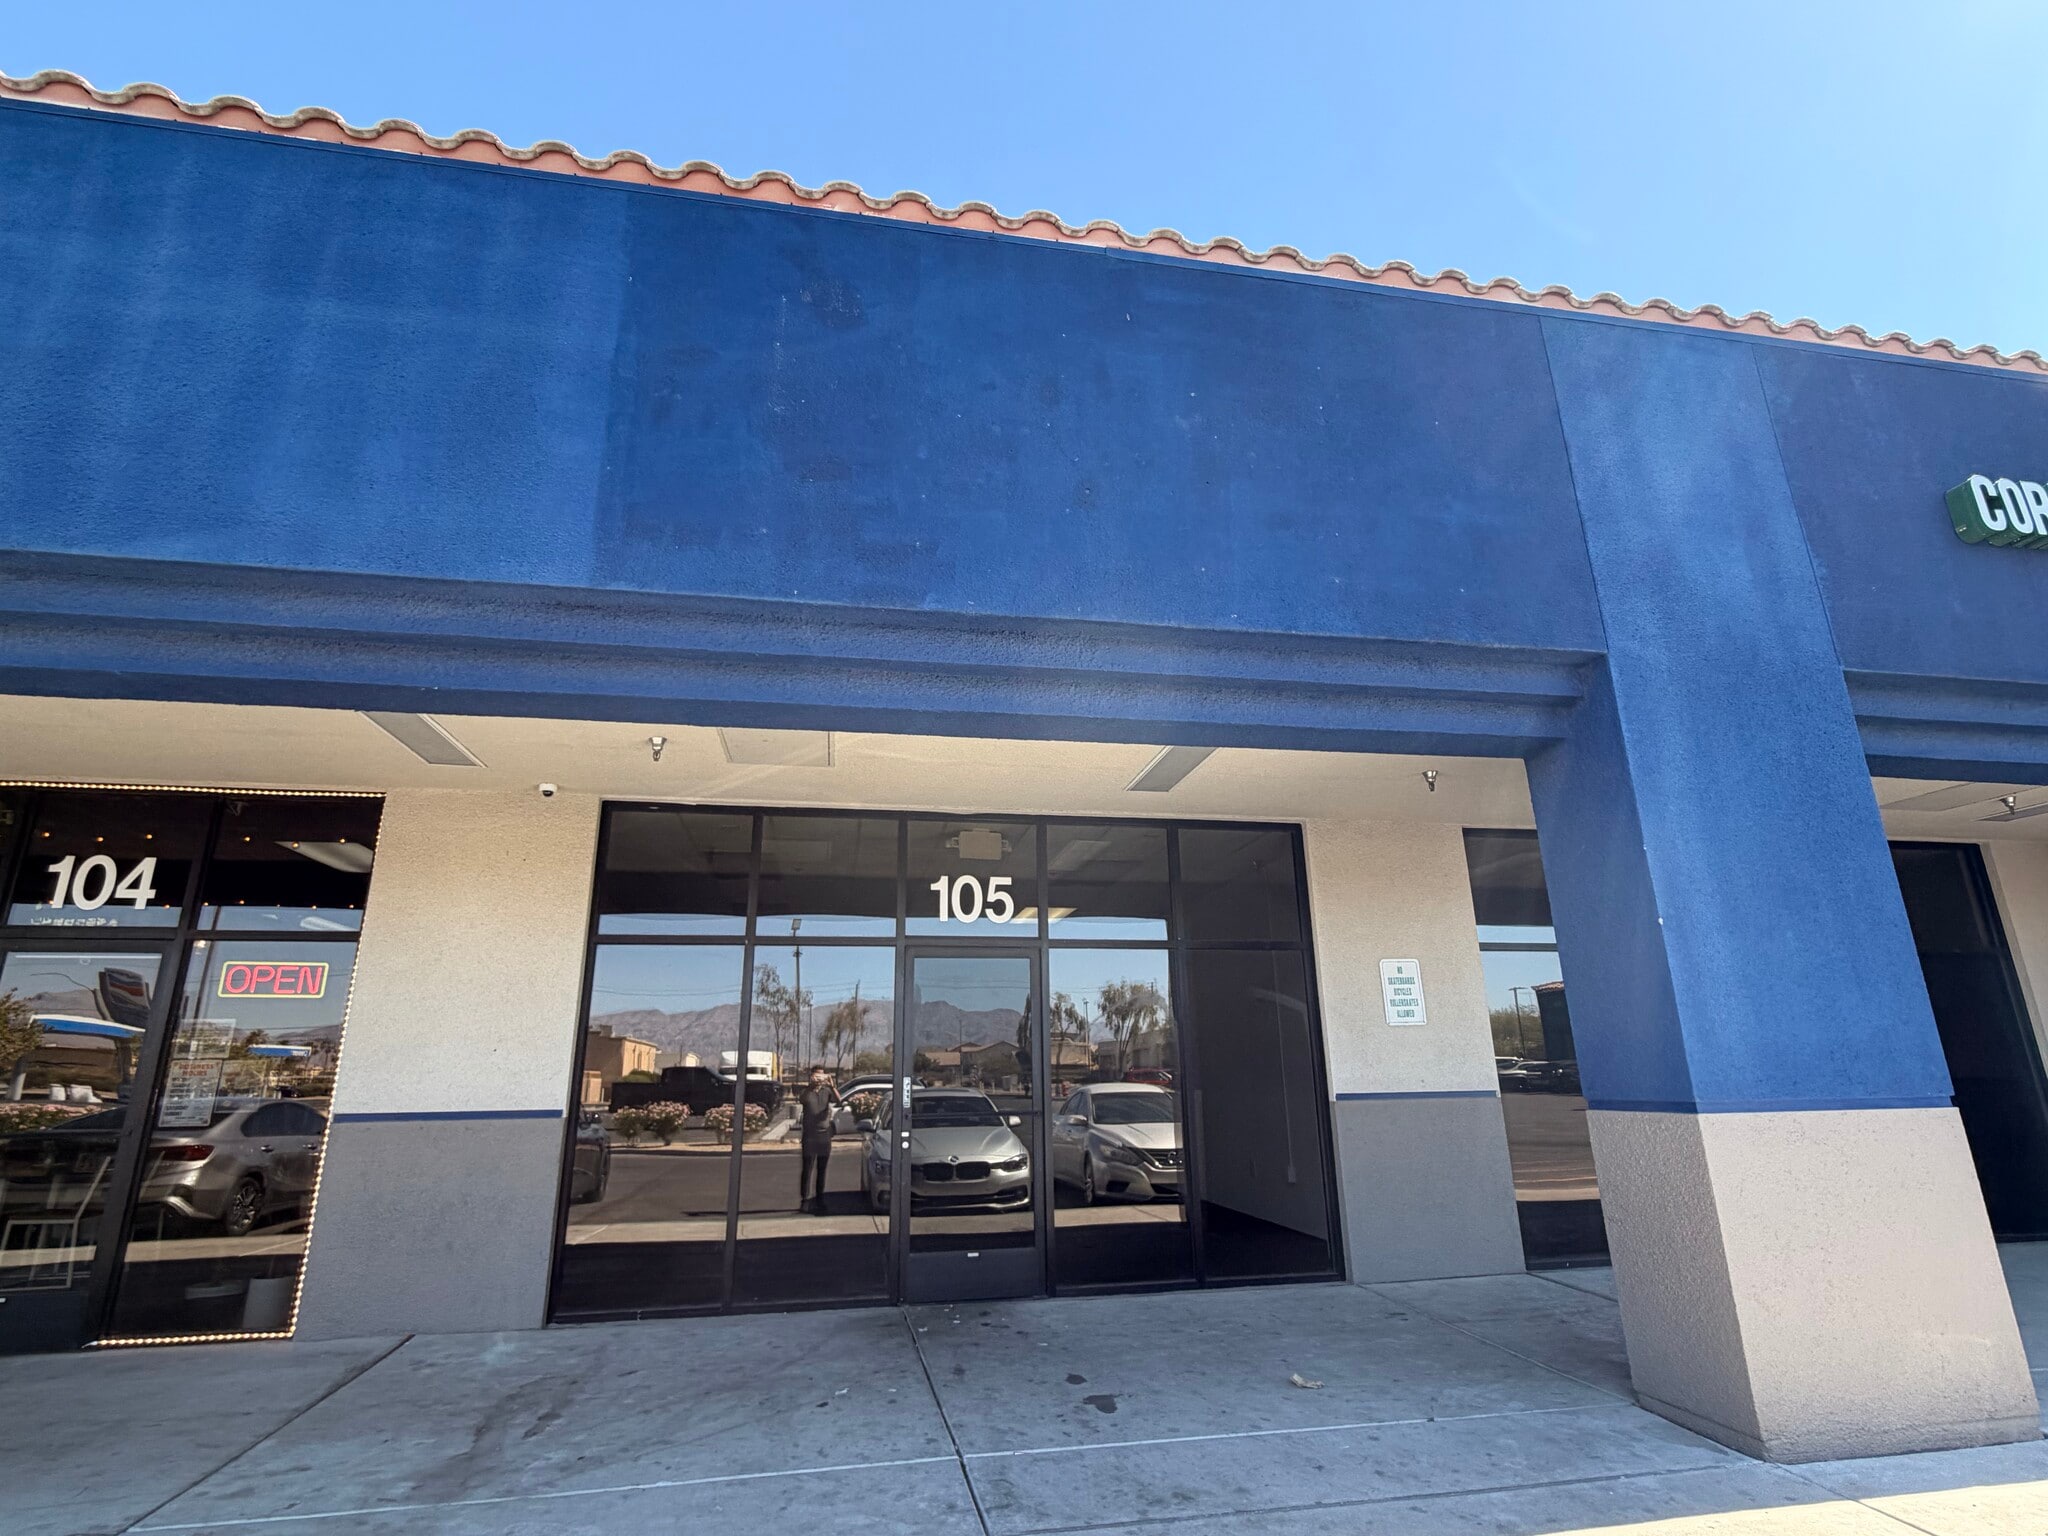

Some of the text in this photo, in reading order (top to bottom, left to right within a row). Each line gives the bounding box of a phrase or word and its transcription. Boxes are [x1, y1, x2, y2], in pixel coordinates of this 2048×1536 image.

[48, 855, 157, 910] 104
[930, 874, 1014, 924] 105
[225, 965, 323, 994] OPEN
[1393, 988, 1412, 996] BICYCLES
[1397, 1009, 1415, 1018] ALLOWED
